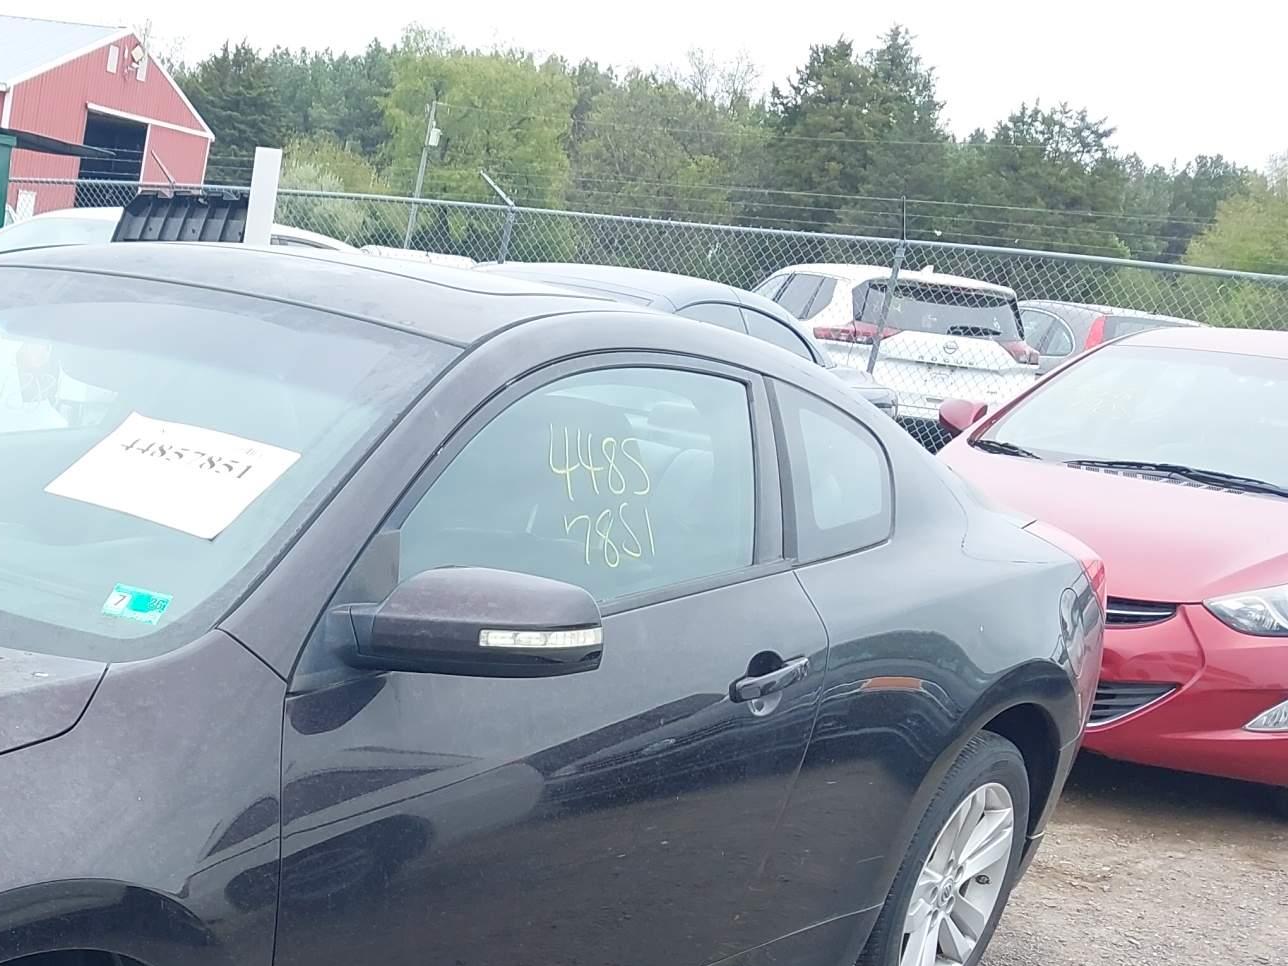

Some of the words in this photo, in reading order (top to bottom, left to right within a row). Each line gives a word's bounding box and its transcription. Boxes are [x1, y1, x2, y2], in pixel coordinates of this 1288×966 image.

[120, 438, 253, 479] 44857851
[549, 423, 650, 502] 4485
[563, 502, 655, 568] 7851
[113, 594, 127, 606] 7
